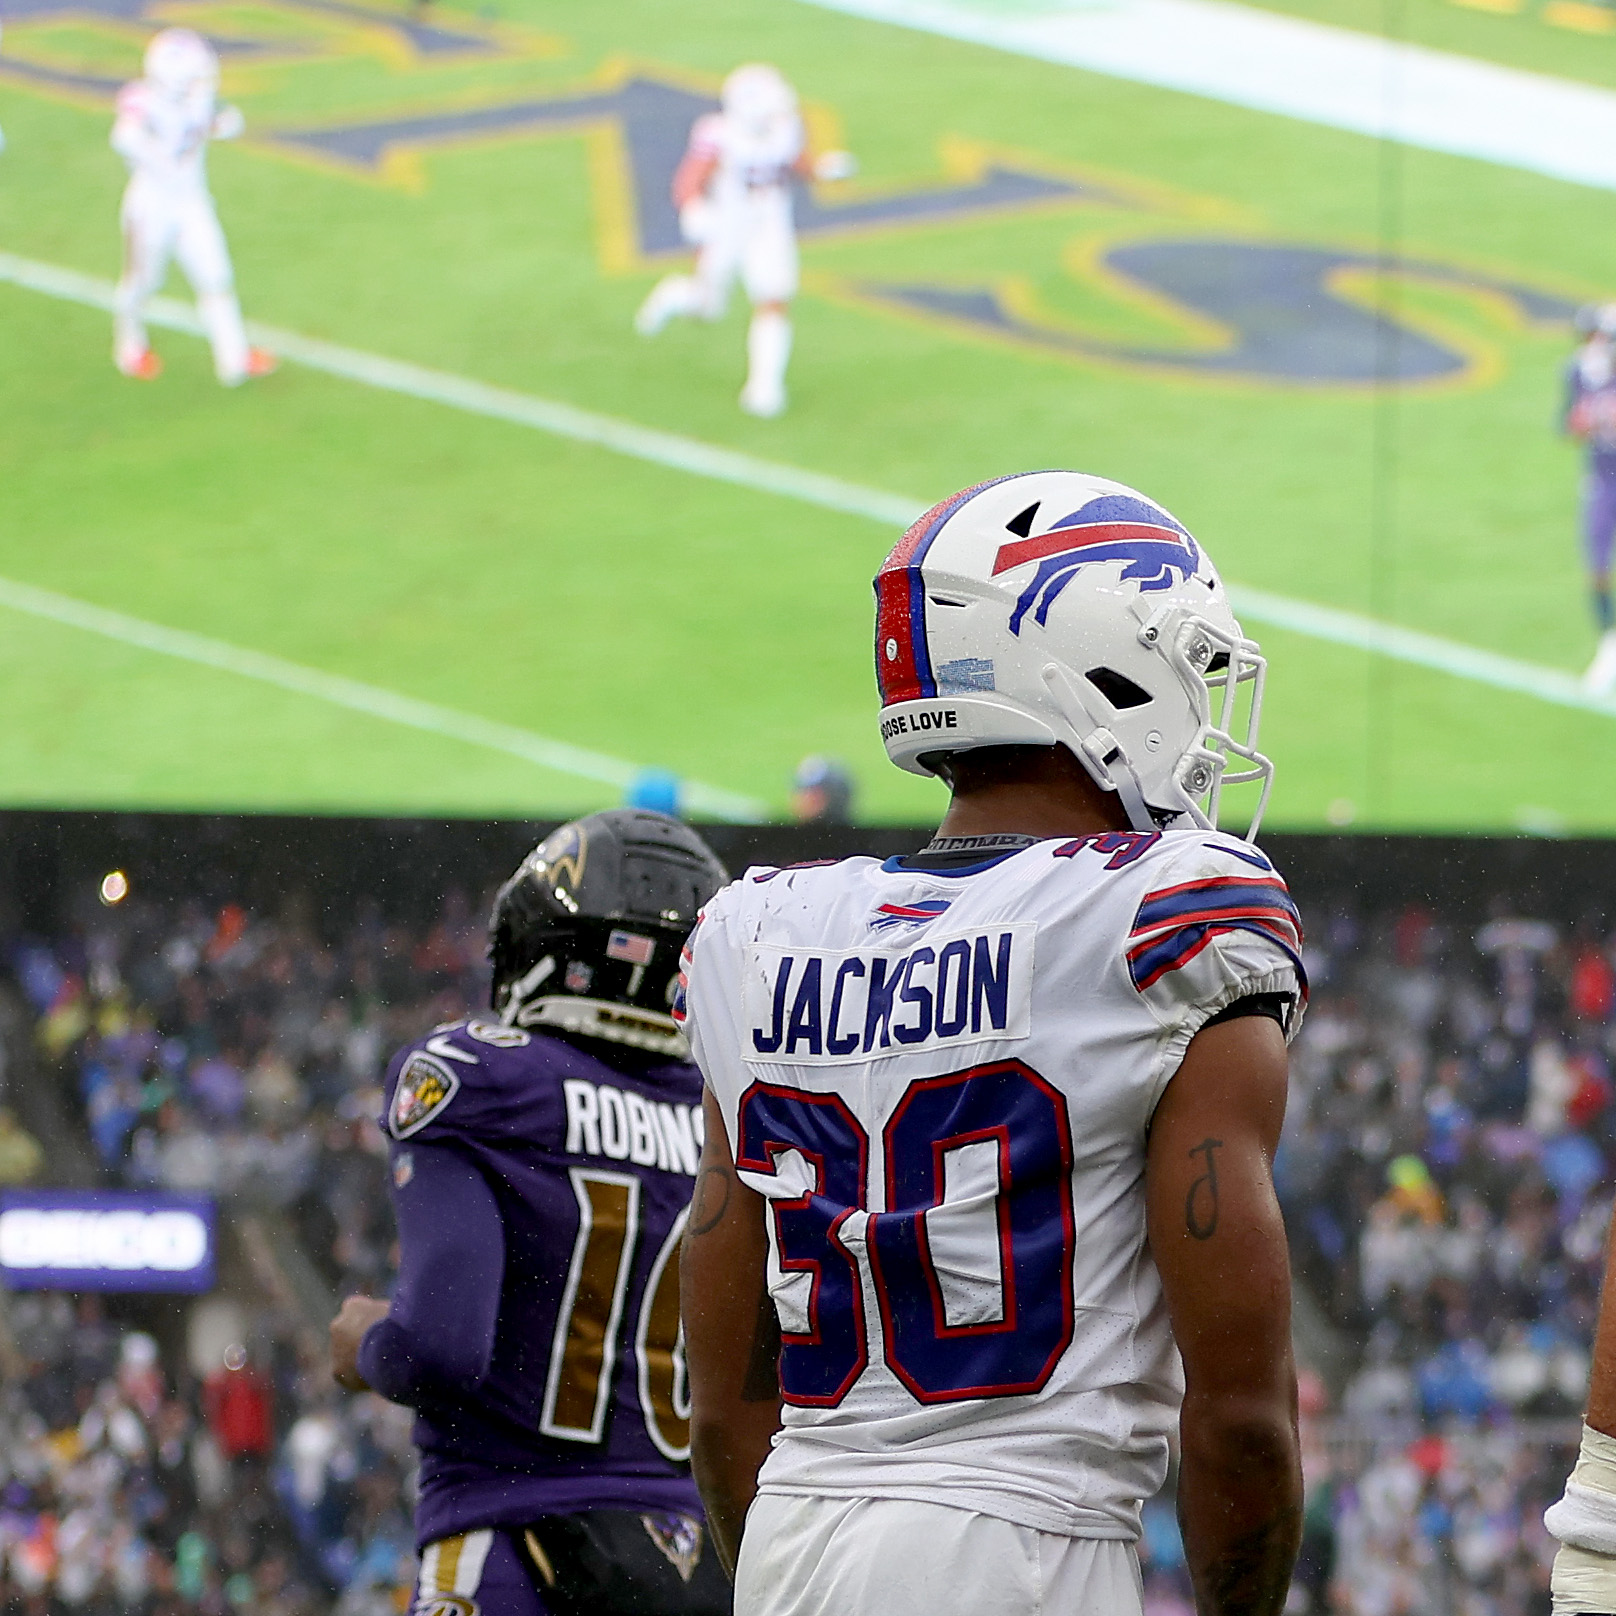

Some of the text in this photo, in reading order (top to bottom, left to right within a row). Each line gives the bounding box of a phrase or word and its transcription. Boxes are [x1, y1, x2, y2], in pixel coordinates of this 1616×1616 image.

[910, 710, 957, 731] LOVE
[753, 933, 1013, 1056] JACKSON
[736, 1058, 1076, 1408] 30
